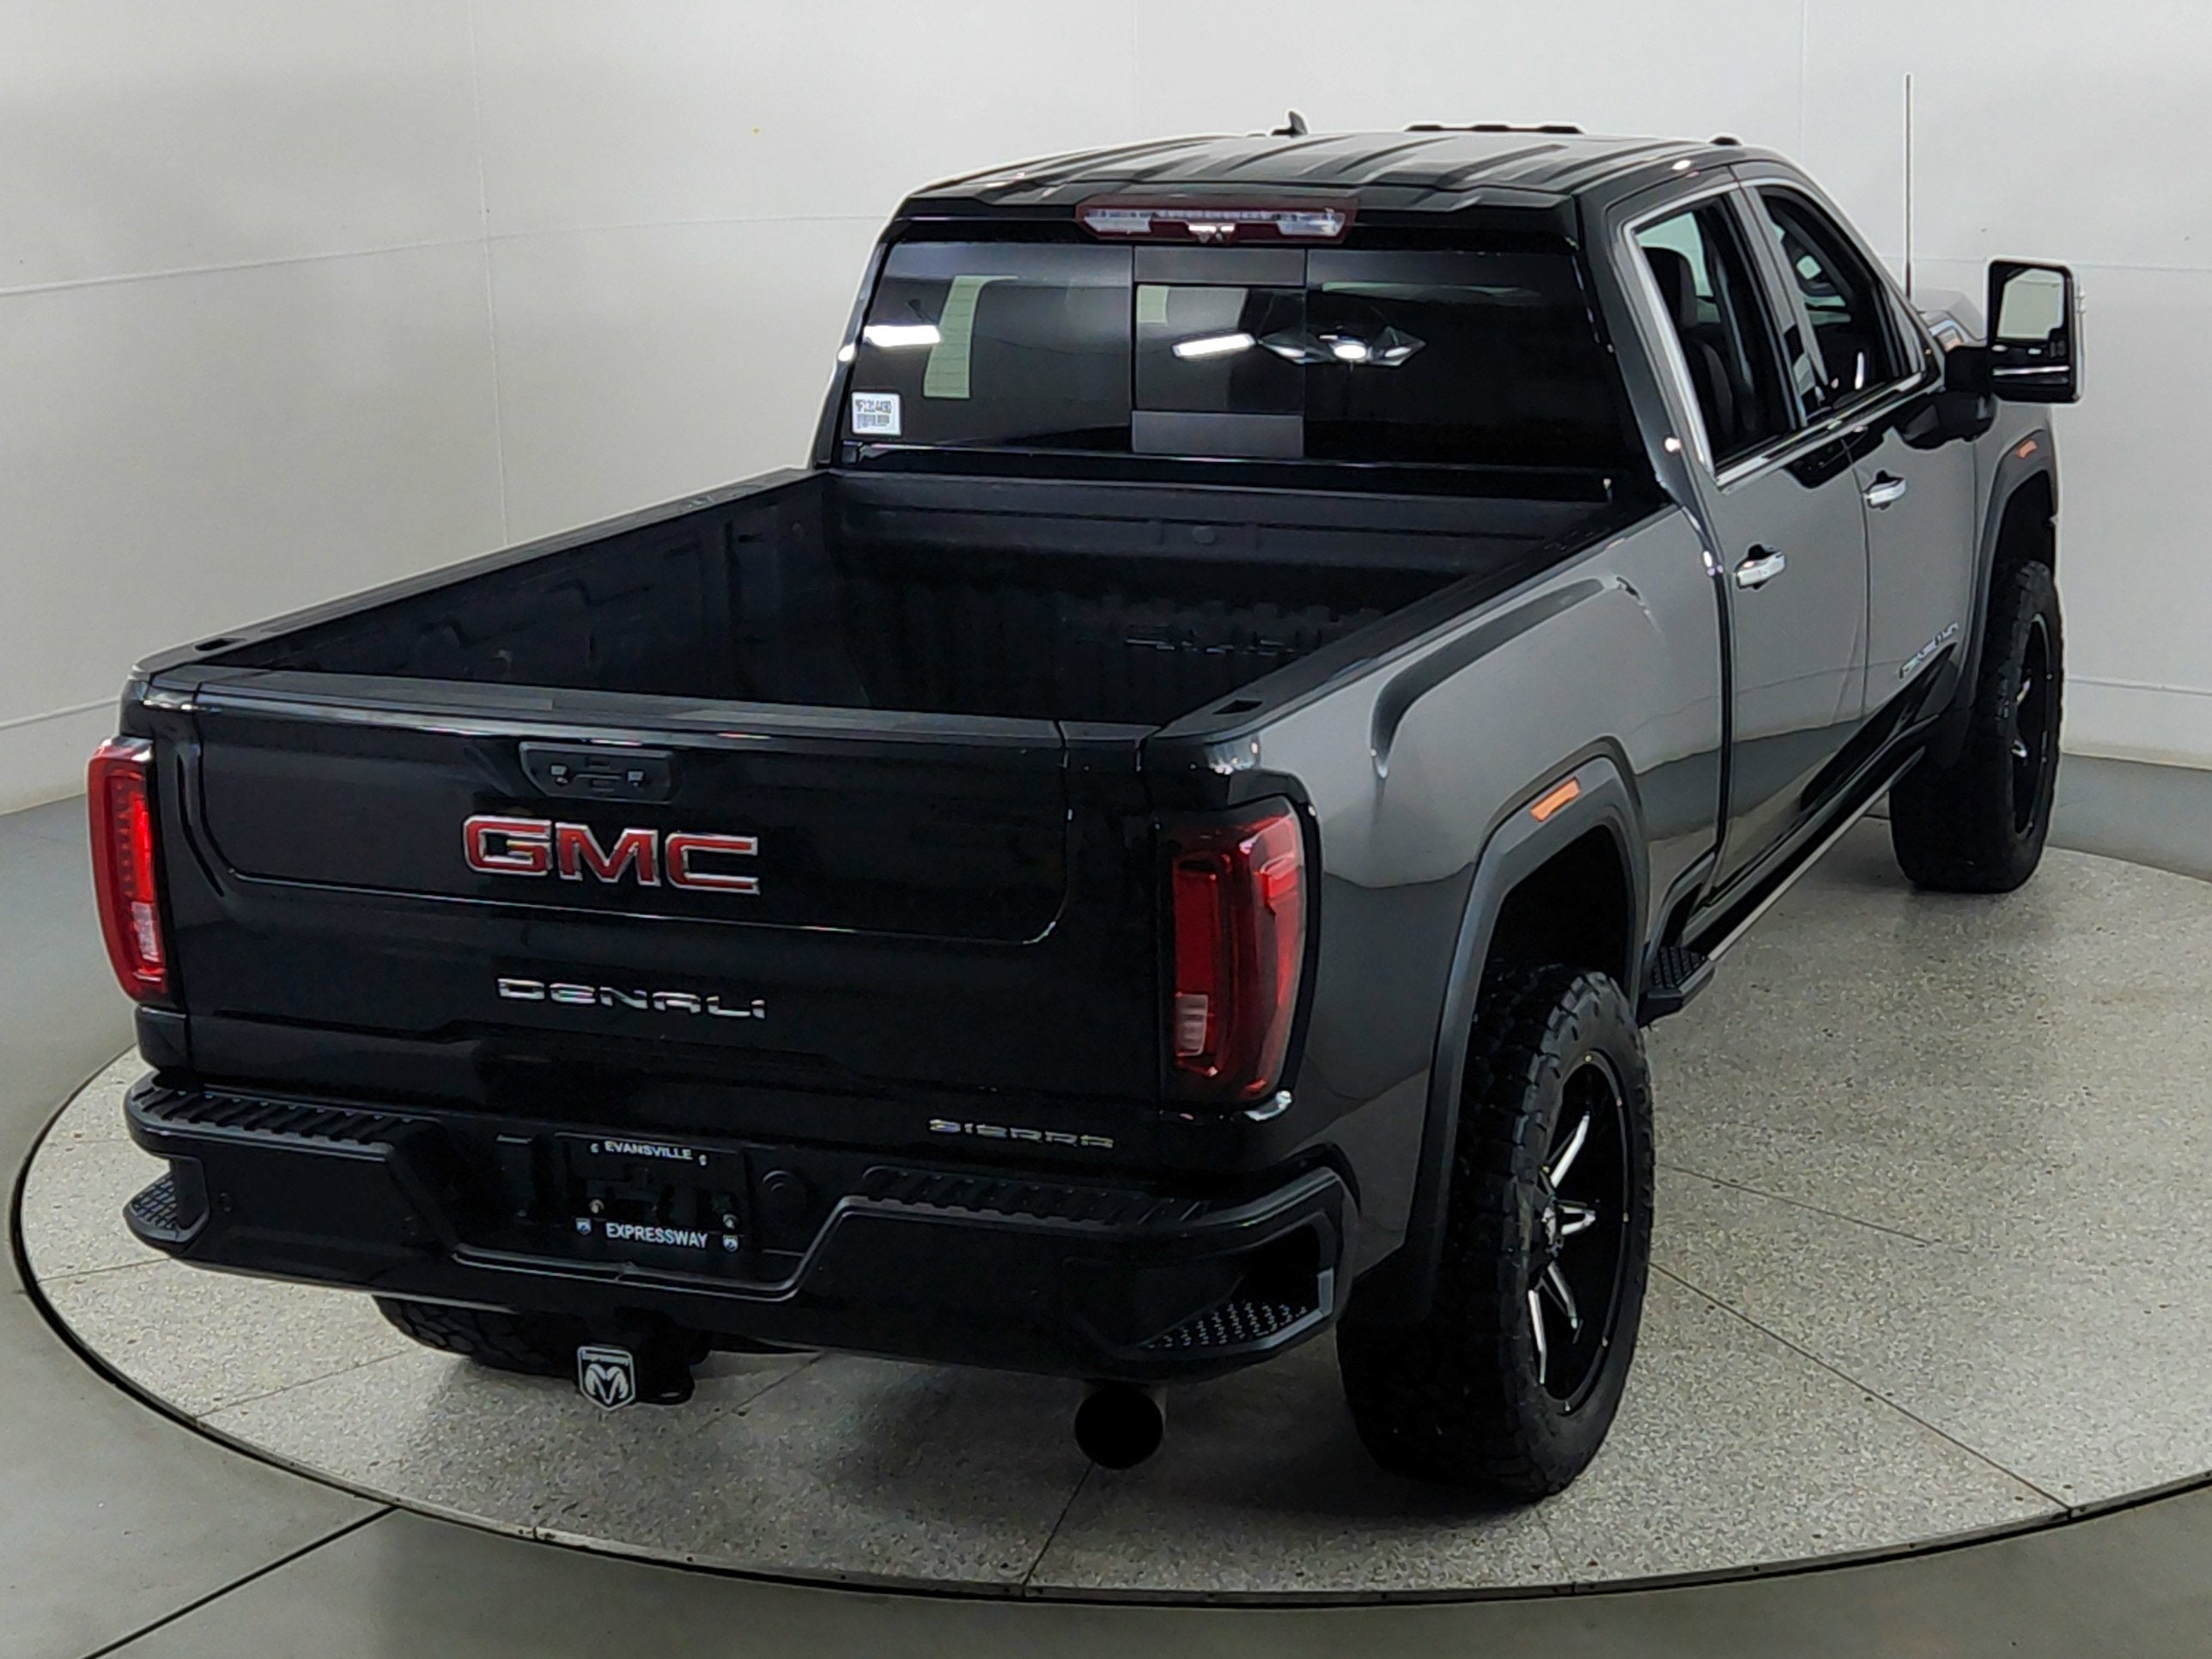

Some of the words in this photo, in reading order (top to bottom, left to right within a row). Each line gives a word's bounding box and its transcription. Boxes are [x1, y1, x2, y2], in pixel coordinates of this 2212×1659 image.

[464, 815, 760, 895] GMC
[497, 978, 765, 1019] DENALI
[604, 1140, 693, 1160] EVANSVILLE
[606, 1222, 708, 1248] EXPRESSWAY
